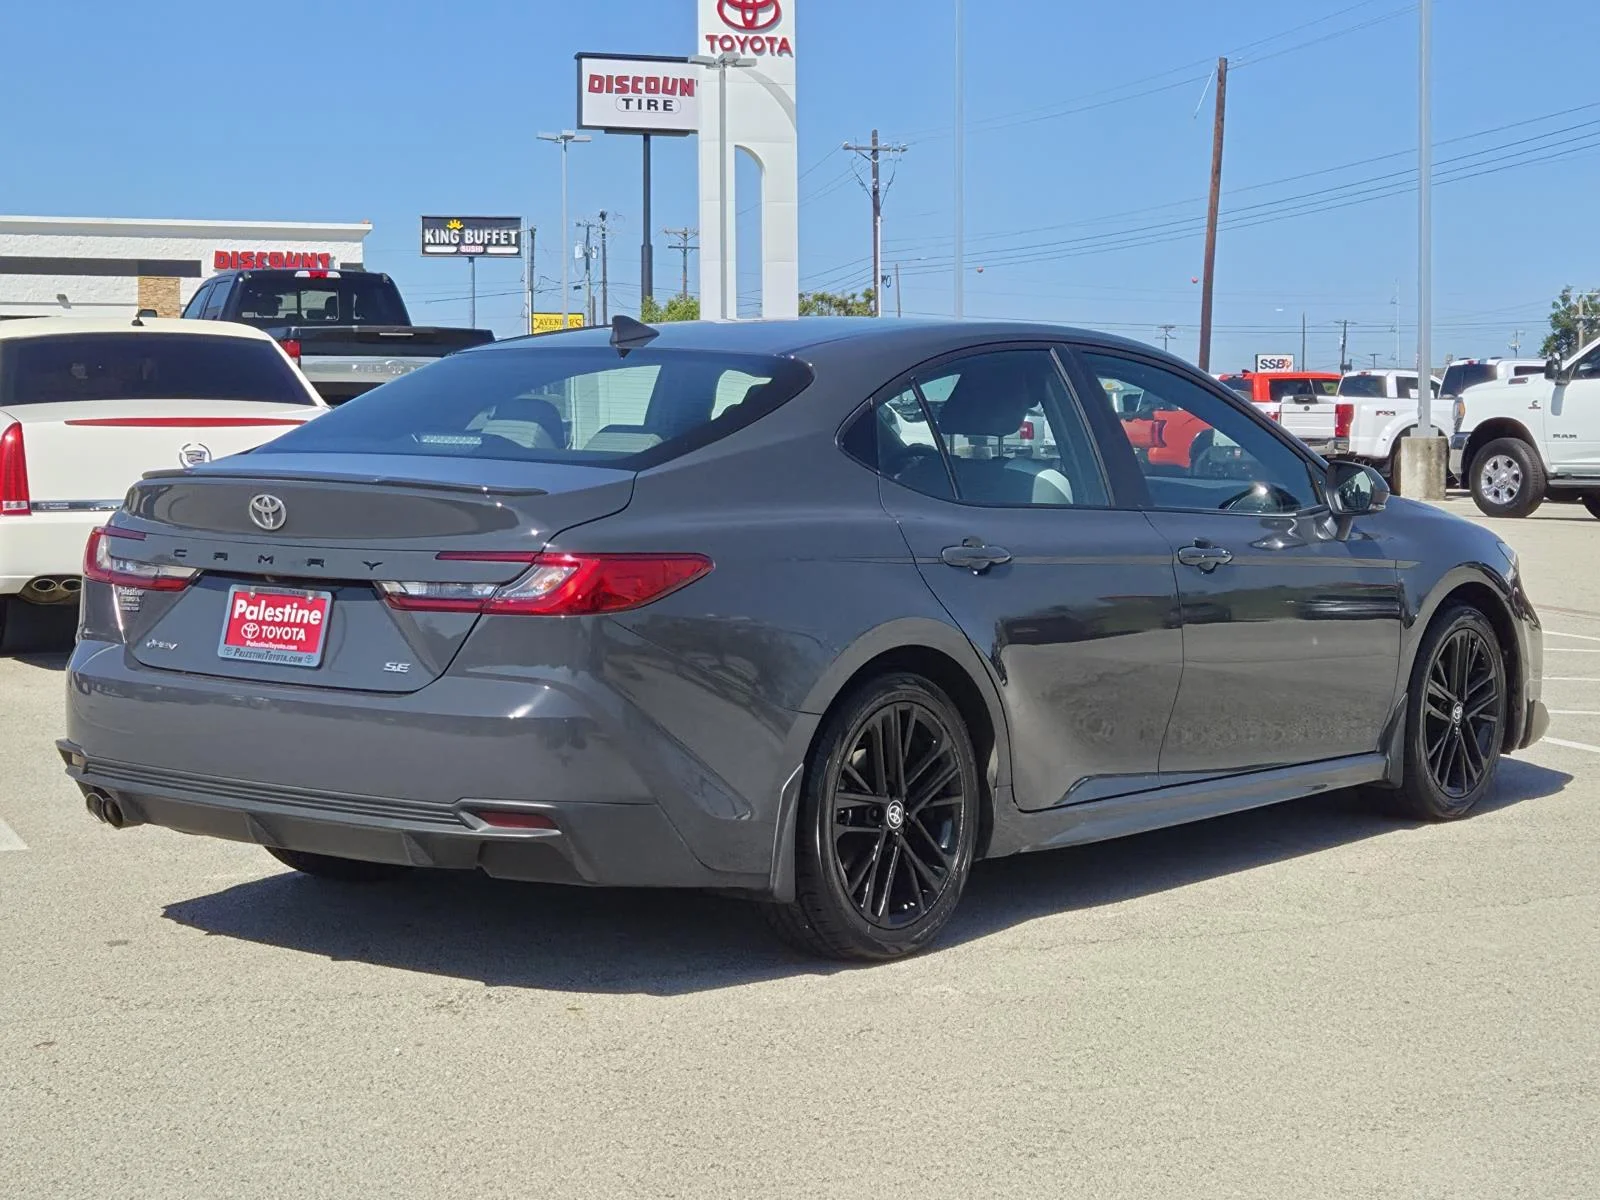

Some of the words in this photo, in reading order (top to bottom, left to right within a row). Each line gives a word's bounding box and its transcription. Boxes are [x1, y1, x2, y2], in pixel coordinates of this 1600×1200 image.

[705, 34, 793, 57] TOYOTA
[588, 74, 698, 97] DISCOUN
[621, 98, 674, 112] TIRE
[425, 229, 460, 244] KING
[464, 229, 518, 245] BUFFET
[214, 250, 331, 269] DISCOUNT
[174, 549, 383, 571] CAMRY
[234, 599, 322, 625] Palestine
[261, 625, 306, 641] TOYOTA
[384, 662, 411, 673] SE
